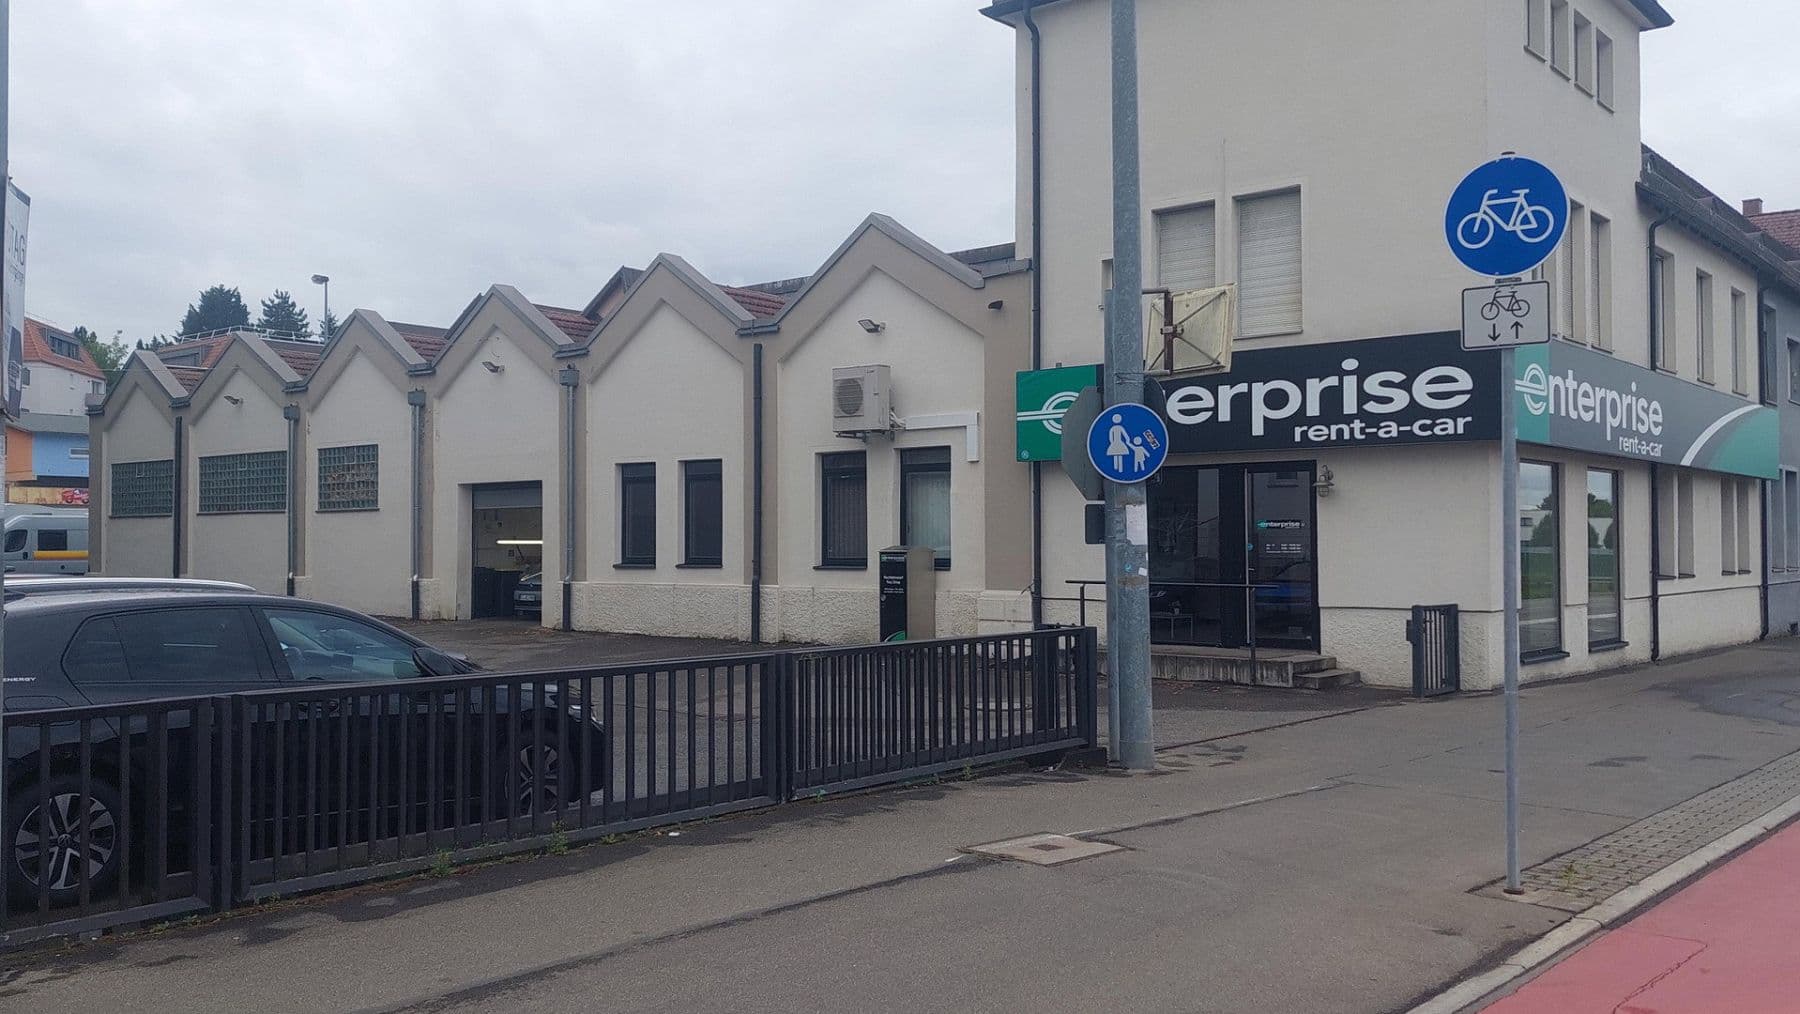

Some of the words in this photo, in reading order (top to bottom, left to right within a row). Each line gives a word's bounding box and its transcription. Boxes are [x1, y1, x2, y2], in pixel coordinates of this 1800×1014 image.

[1515, 363, 1663, 441] enterprise
[1294, 416, 1472, 442] rent-a-car
[1619, 435, 1663, 457] rent-a-car
